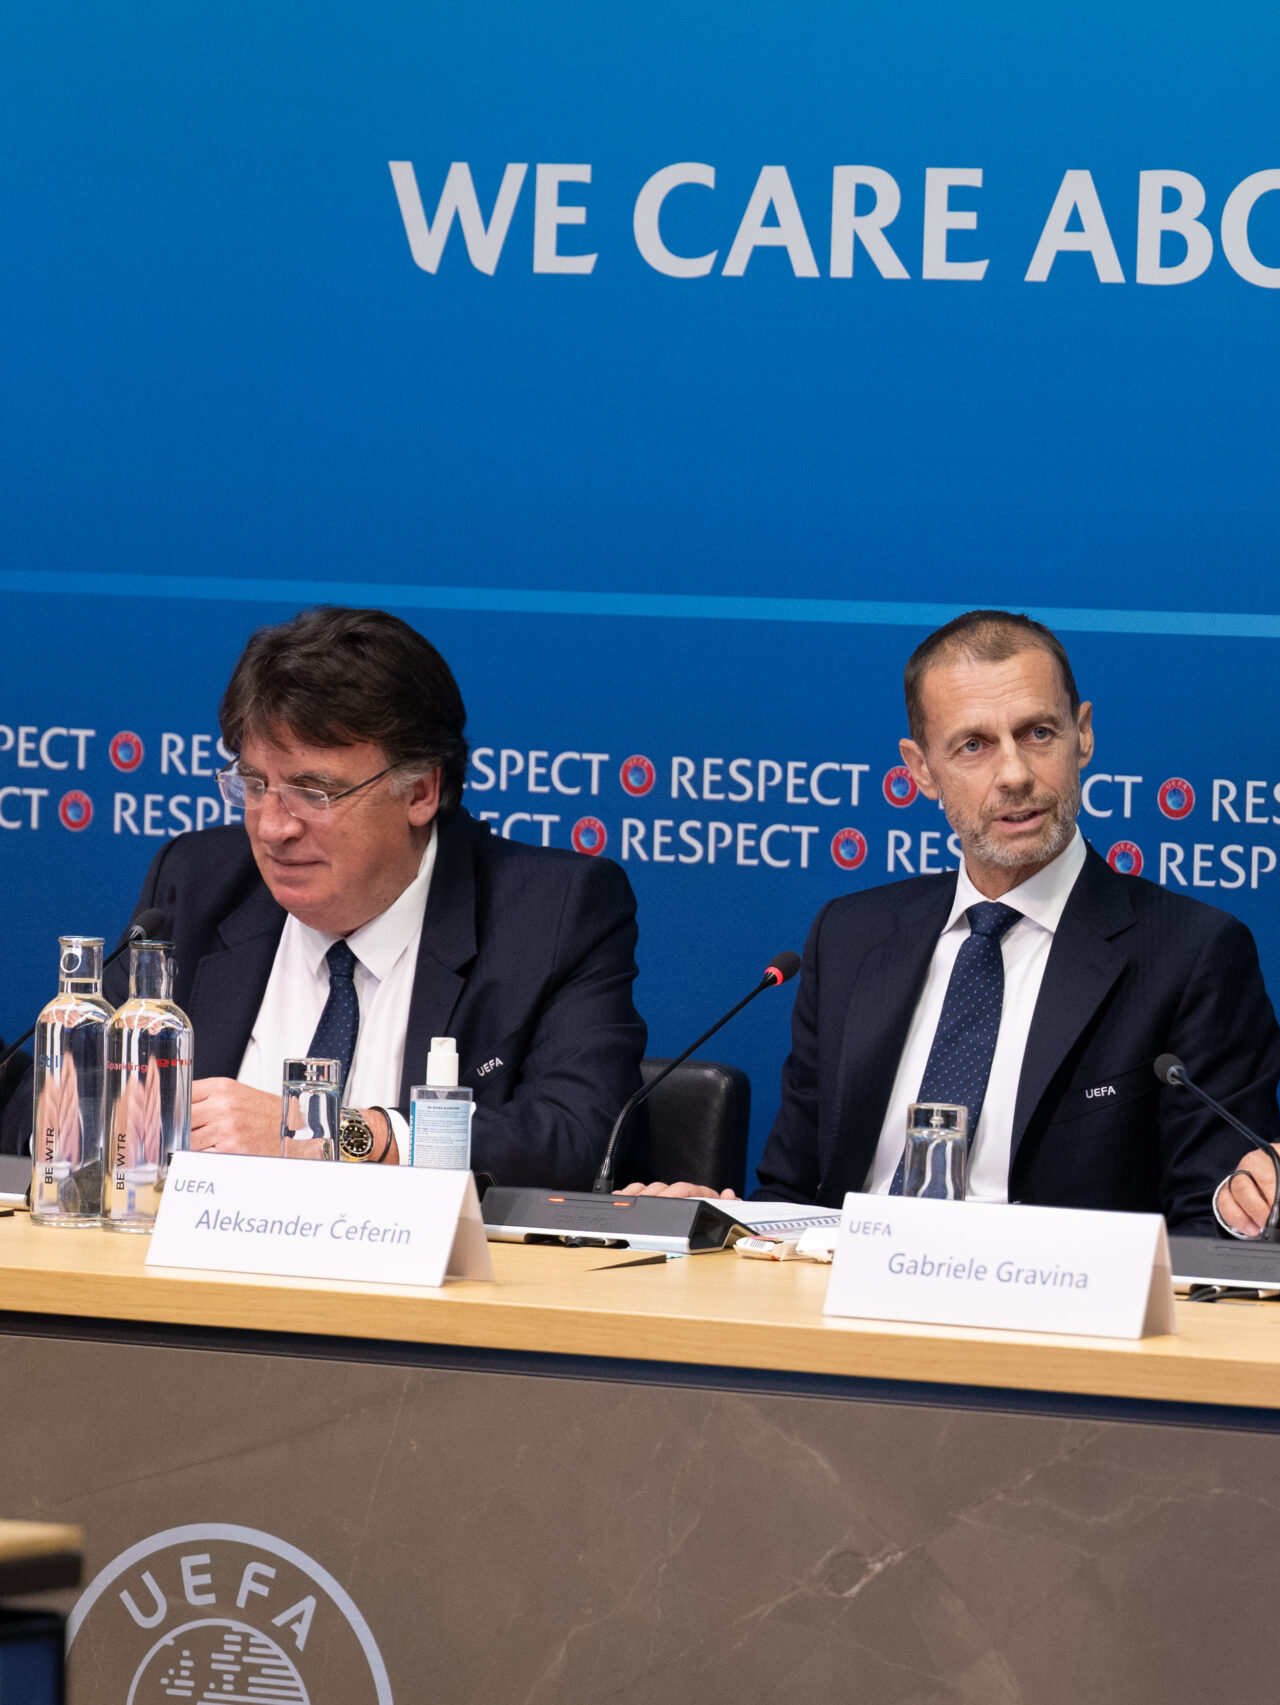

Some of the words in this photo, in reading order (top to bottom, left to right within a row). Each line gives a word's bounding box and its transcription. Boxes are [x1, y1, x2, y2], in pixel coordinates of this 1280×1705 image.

[388, 160, 598, 276] WE
[633, 162, 990, 281] CARE
[463, 747, 610, 795] SPECT
[671, 756, 869, 806] RESPECT
[622, 818, 819, 868] RESPECT
[39, 1054, 63, 1068] Still
[476, 1057, 504, 1077] UEFA
[1085, 1085, 1117, 1099] UEFA
[45, 1128, 54, 1161] WTR
[117, 1133, 126, 1166] WTR
[45, 1167, 53, 1184] BE
[116, 1172, 125, 1190] BE
[174, 1179, 215, 1194] UEFA
[195, 1209, 322, 1238] Aleksander
[330, 1213, 412, 1244] Čeferin
[849, 1220, 893, 1237] UEFA
[888, 1253, 988, 1281] Gabriele
[996, 1261, 1089, 1289] Gravina
[119, 1553, 317, 1651] UEFA
